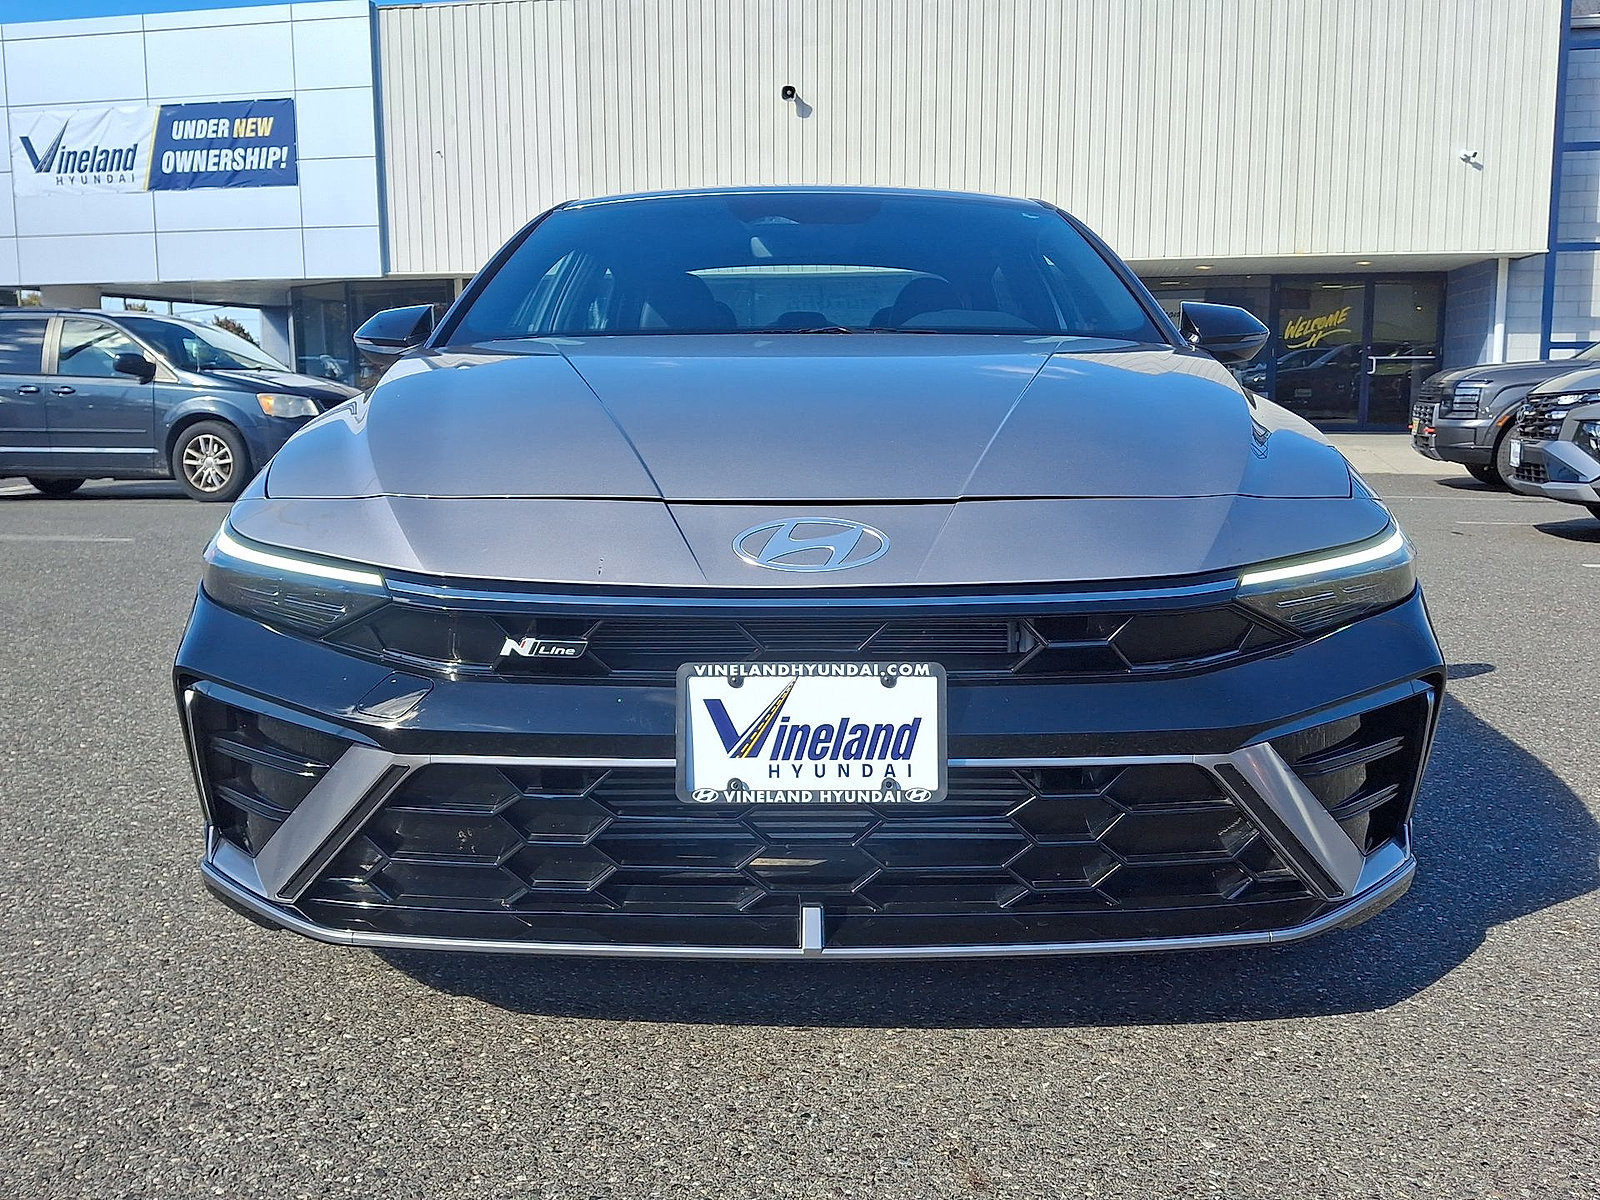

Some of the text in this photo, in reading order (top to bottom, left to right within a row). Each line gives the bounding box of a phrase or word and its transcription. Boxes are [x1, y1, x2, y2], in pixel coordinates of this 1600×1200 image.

[171, 117, 275, 140] UNDER NEW
[19, 116, 138, 174] Vineland
[161, 146, 289, 175] OWNERSHIP!
[55, 174, 136, 185] HYUNDAI
[1283, 306, 1353, 340] WELCOME
[538, 646, 576, 655] Line
[693, 663, 931, 677] VINELANDHYUNDAI.COM
[702, 676, 922, 761] Vineland
[768, 763, 912, 778] HYUNDAI
[723, 790, 902, 803] VINELAND HYUNDAI
